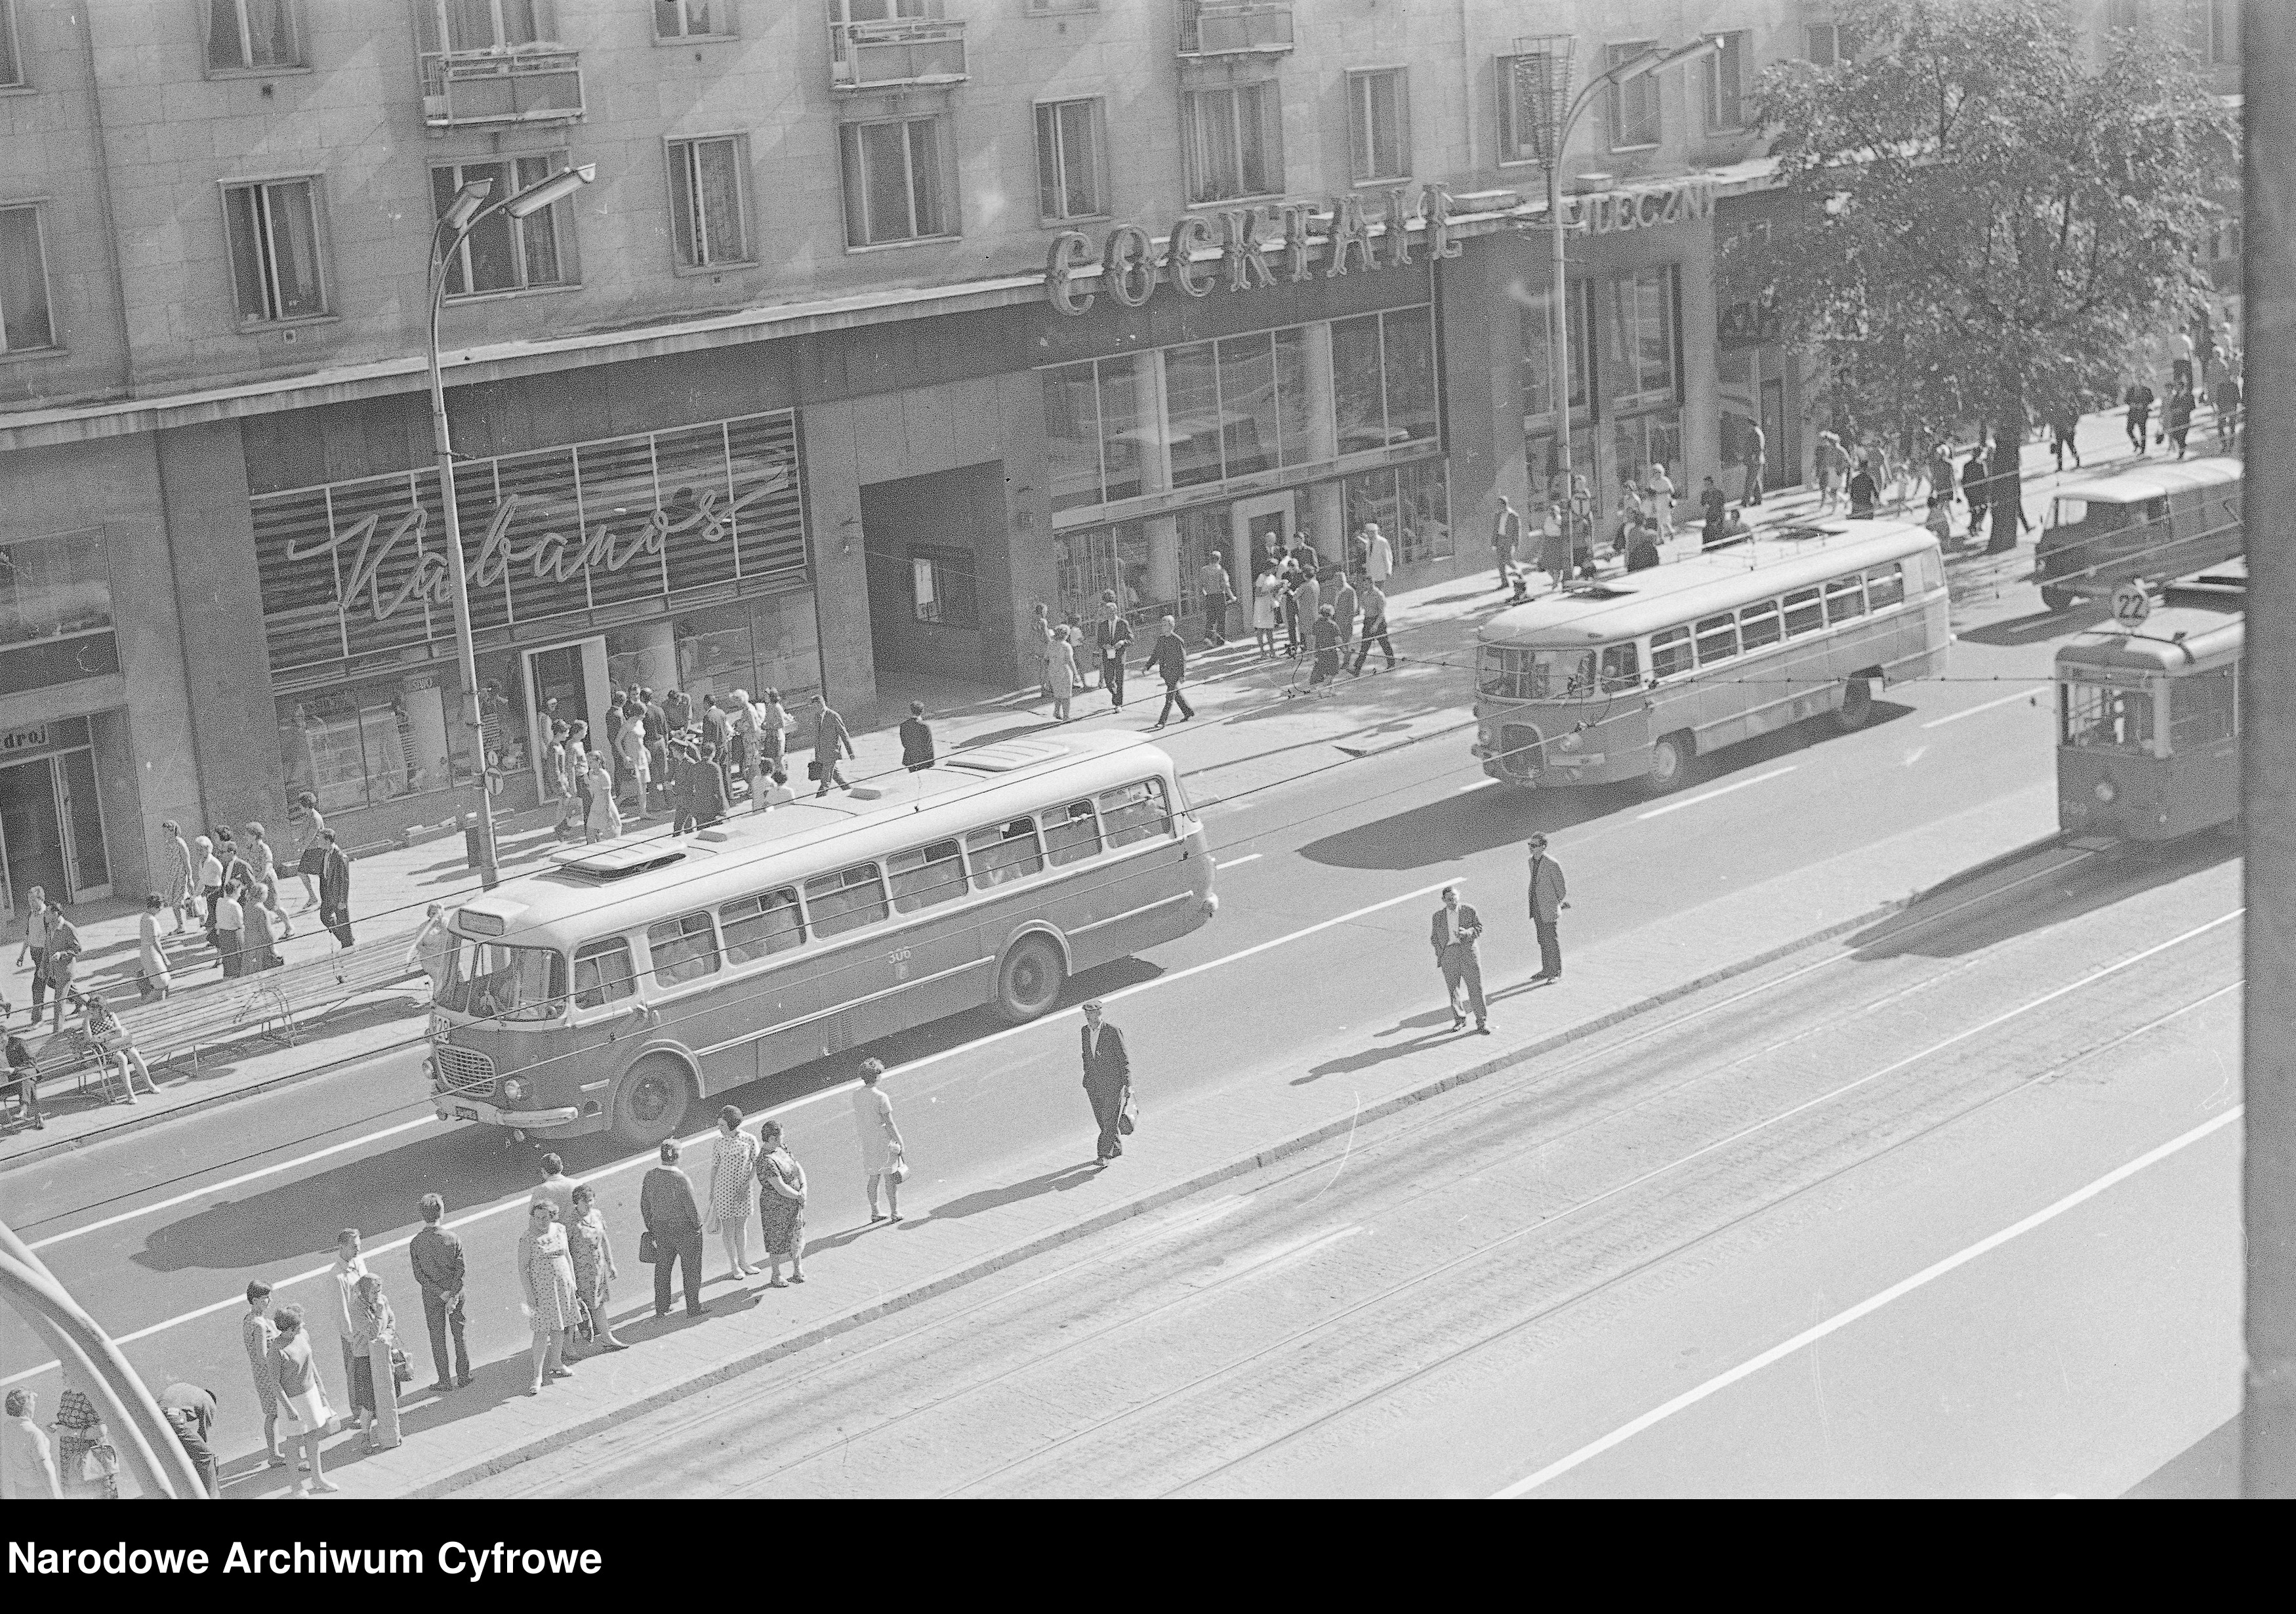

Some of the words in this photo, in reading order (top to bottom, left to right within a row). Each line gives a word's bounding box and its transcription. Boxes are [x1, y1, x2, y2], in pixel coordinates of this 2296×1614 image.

[1047, 180, 1463, 316] COCKTAIL
[287, 465, 787, 620] Kabanos
[2119, 594, 2145, 619] 22
